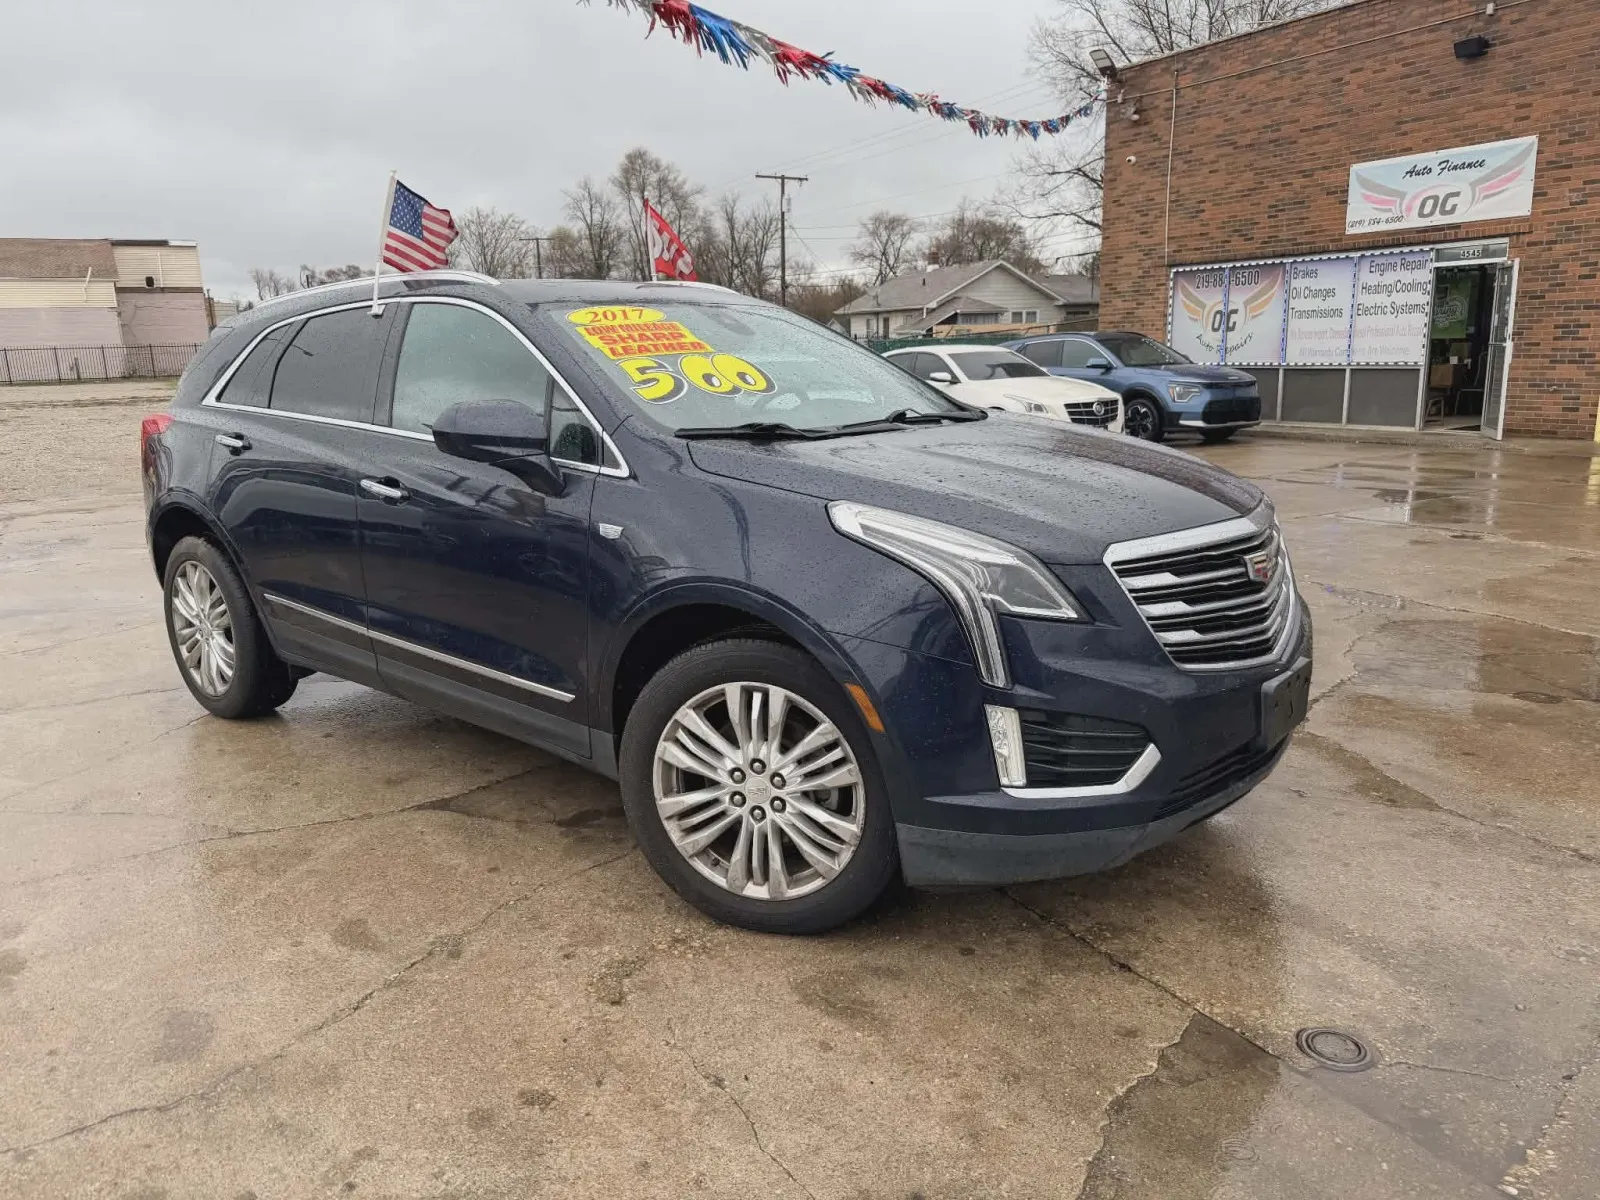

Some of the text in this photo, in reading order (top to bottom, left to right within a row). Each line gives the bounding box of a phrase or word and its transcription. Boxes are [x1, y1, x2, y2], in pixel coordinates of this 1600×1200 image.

[1402, 158, 1486, 180] Auto Finance
[1417, 191, 1461, 218] OG
[1461, 249, 1481, 258] 4545
[1292, 266, 1318, 280] Brakes
[1369, 256, 1428, 276] Engine Repair
[1196, 270, 1260, 289] 219-88-6500
[1291, 286, 1336, 301] Oil Changes
[585, 308, 644, 323] 2017
[1290, 305, 1343, 320] Transmissions
[1357, 302, 1388, 316] Electric
[1390, 300, 1426, 318] Systems
[598, 331, 687, 345] SHARP
[1196, 333, 1214, 352] Auto
[608, 341, 707, 357] LEATHER
